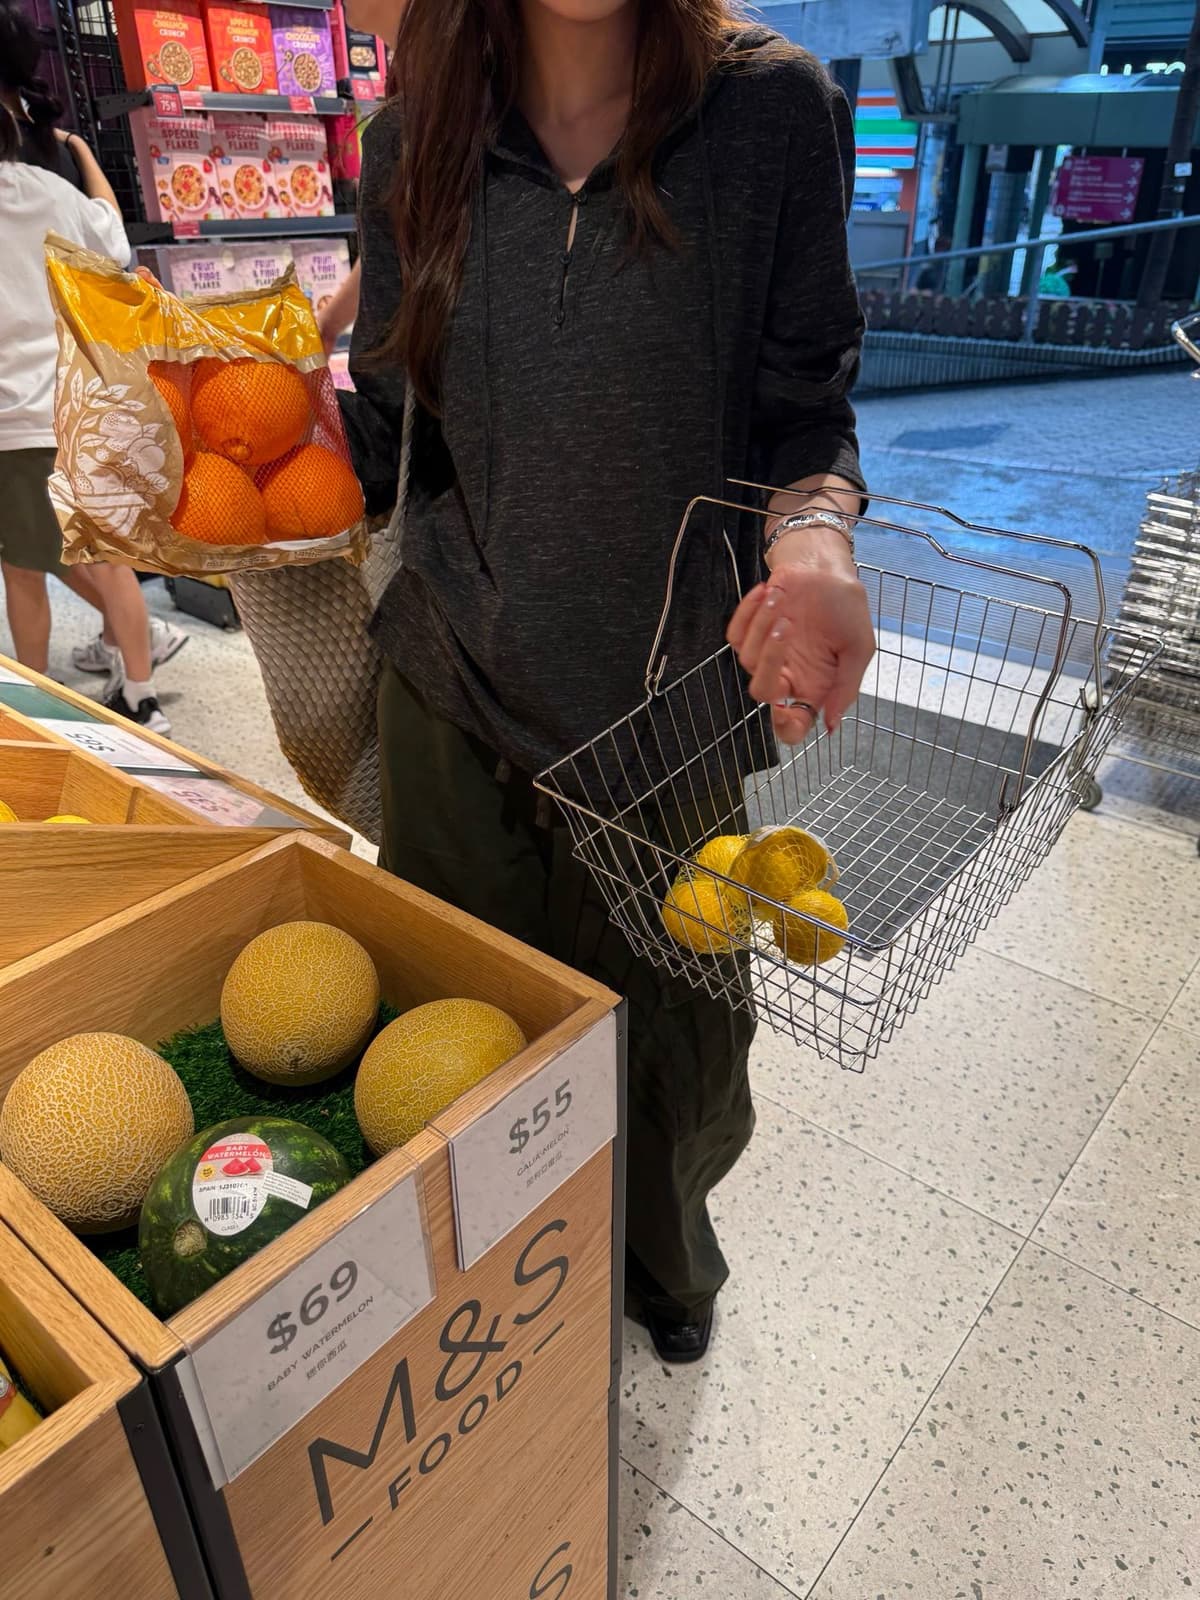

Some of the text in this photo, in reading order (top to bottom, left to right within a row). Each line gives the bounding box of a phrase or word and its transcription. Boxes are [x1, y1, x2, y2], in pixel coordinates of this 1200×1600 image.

[161, 129, 199, 139] SPECIAL
[225, 130, 258, 140] SPECIAL
[165, 140, 199, 150] FLAKES
[228, 141, 259, 151] FLAKES
[286, 141, 315, 151] FLAKES
[312, 273, 336, 281] FLAKES
[194, 281, 220, 290] FLAKES
[508, 1078, 573, 1155] $55
[541, 1126, 570, 1156] MELON
[267, 1260, 358, 1355] $69
[267, 1359, 299, 1391] BABY
[302, 1295, 375, 1361] WATERMELON
[307, 1218, 571, 1527] M&S
[387, 1360, 523, 1512] FOOD
